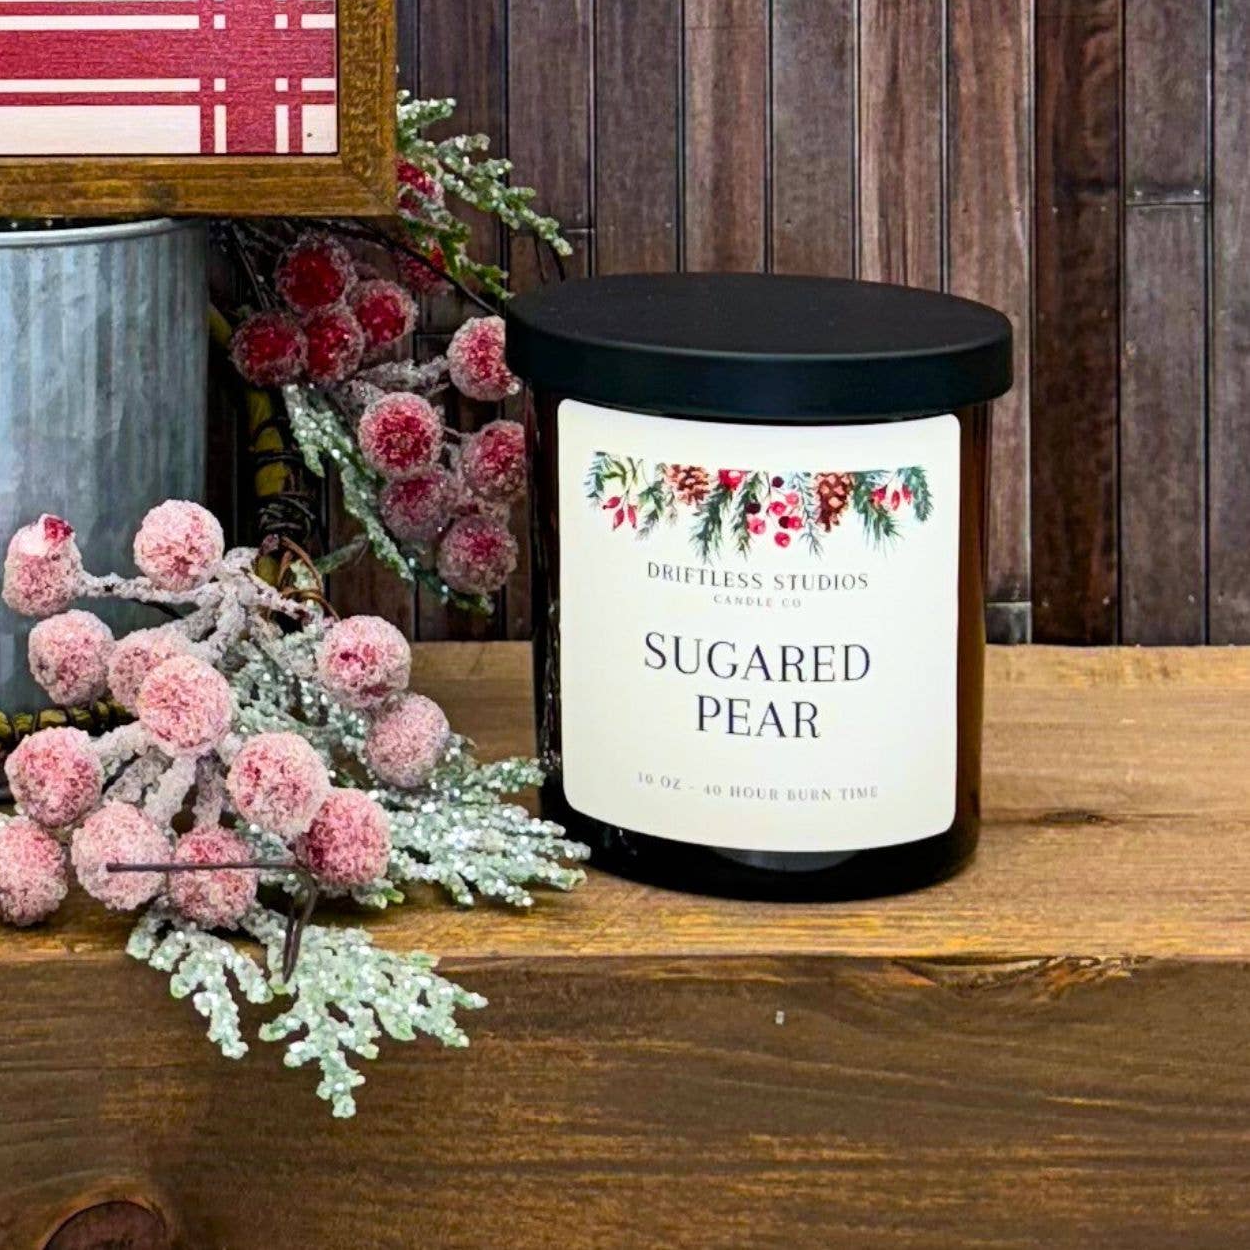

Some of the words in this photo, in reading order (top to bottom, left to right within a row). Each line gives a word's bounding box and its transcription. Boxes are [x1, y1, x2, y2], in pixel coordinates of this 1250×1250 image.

[647, 562, 763, 590] DRIFTLESS
[773, 573, 870, 591] STUDIOS
[712, 594, 774, 608] CANDLE
[781, 597, 802, 608] CO
[643, 631, 871, 683] SUGARED
[695, 694, 821, 739] PEAR
[660, 775, 682, 790] OZ
[703, 784, 723, 797] 40
[729, 784, 779, 801] HOUR
[787, 786, 832, 801] BURN
[838, 786, 879, 799] TIME
